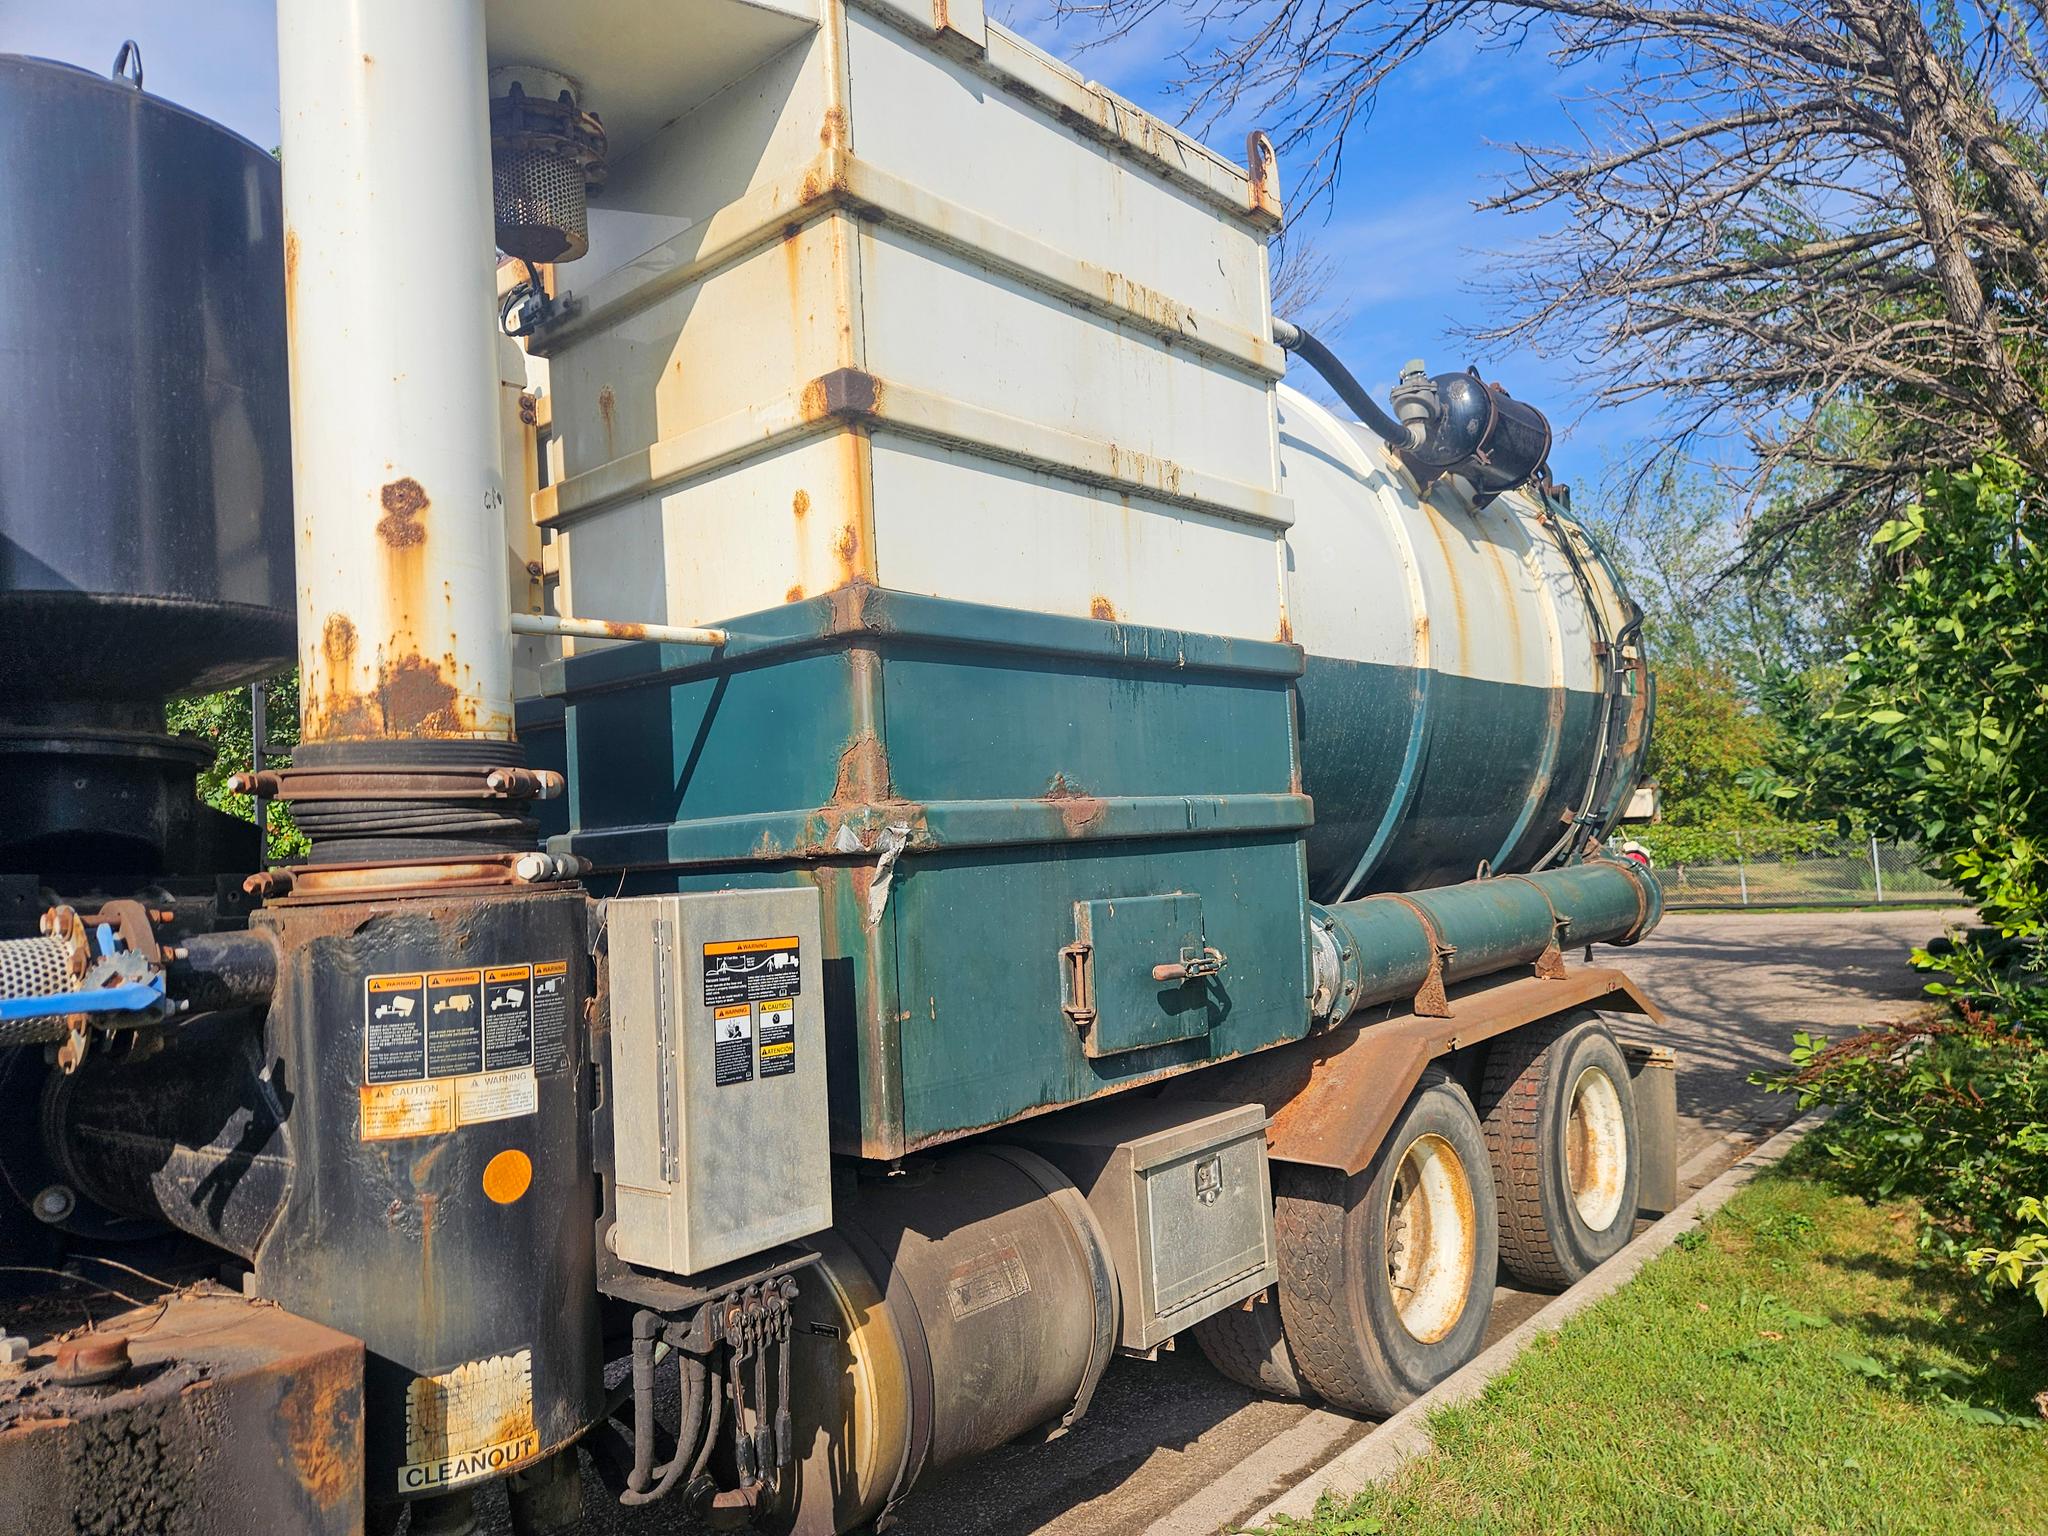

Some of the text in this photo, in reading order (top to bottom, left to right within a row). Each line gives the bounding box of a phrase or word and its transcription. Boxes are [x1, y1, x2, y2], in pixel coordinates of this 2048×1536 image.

[542, 964, 565, 973] WARNING
[500, 970, 526, 978] WARNING
[445, 975, 475, 983] WARNING
[767, 1001, 791, 1010] CAUTION
[484, 1071, 527, 1085] WARNING
[391, 1084, 439, 1097] CAUTION
[405, 1436, 533, 1487] CLEANOUT
